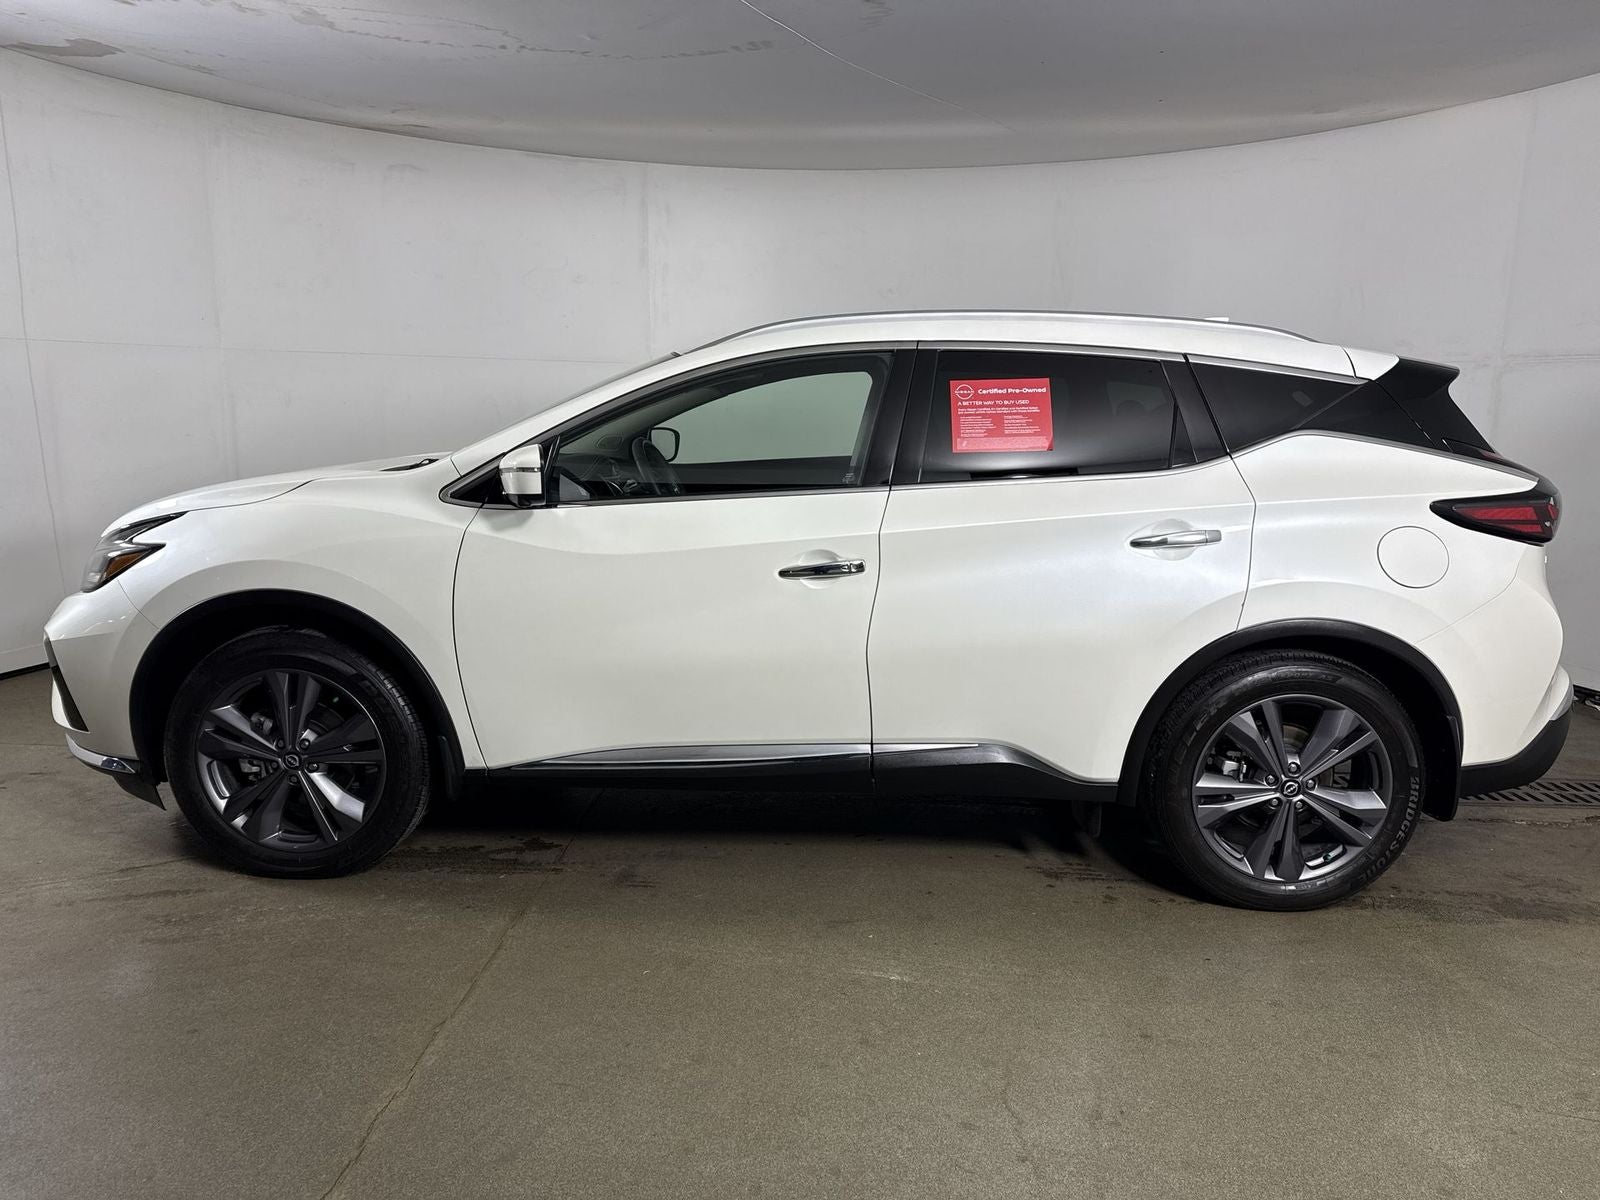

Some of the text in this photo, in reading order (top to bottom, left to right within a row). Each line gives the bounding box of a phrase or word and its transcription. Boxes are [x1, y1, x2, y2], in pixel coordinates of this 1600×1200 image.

[977, 386, 1047, 395] Certified Pre-Owned
[1358, 775, 1421, 882] BRIDGESTONE
